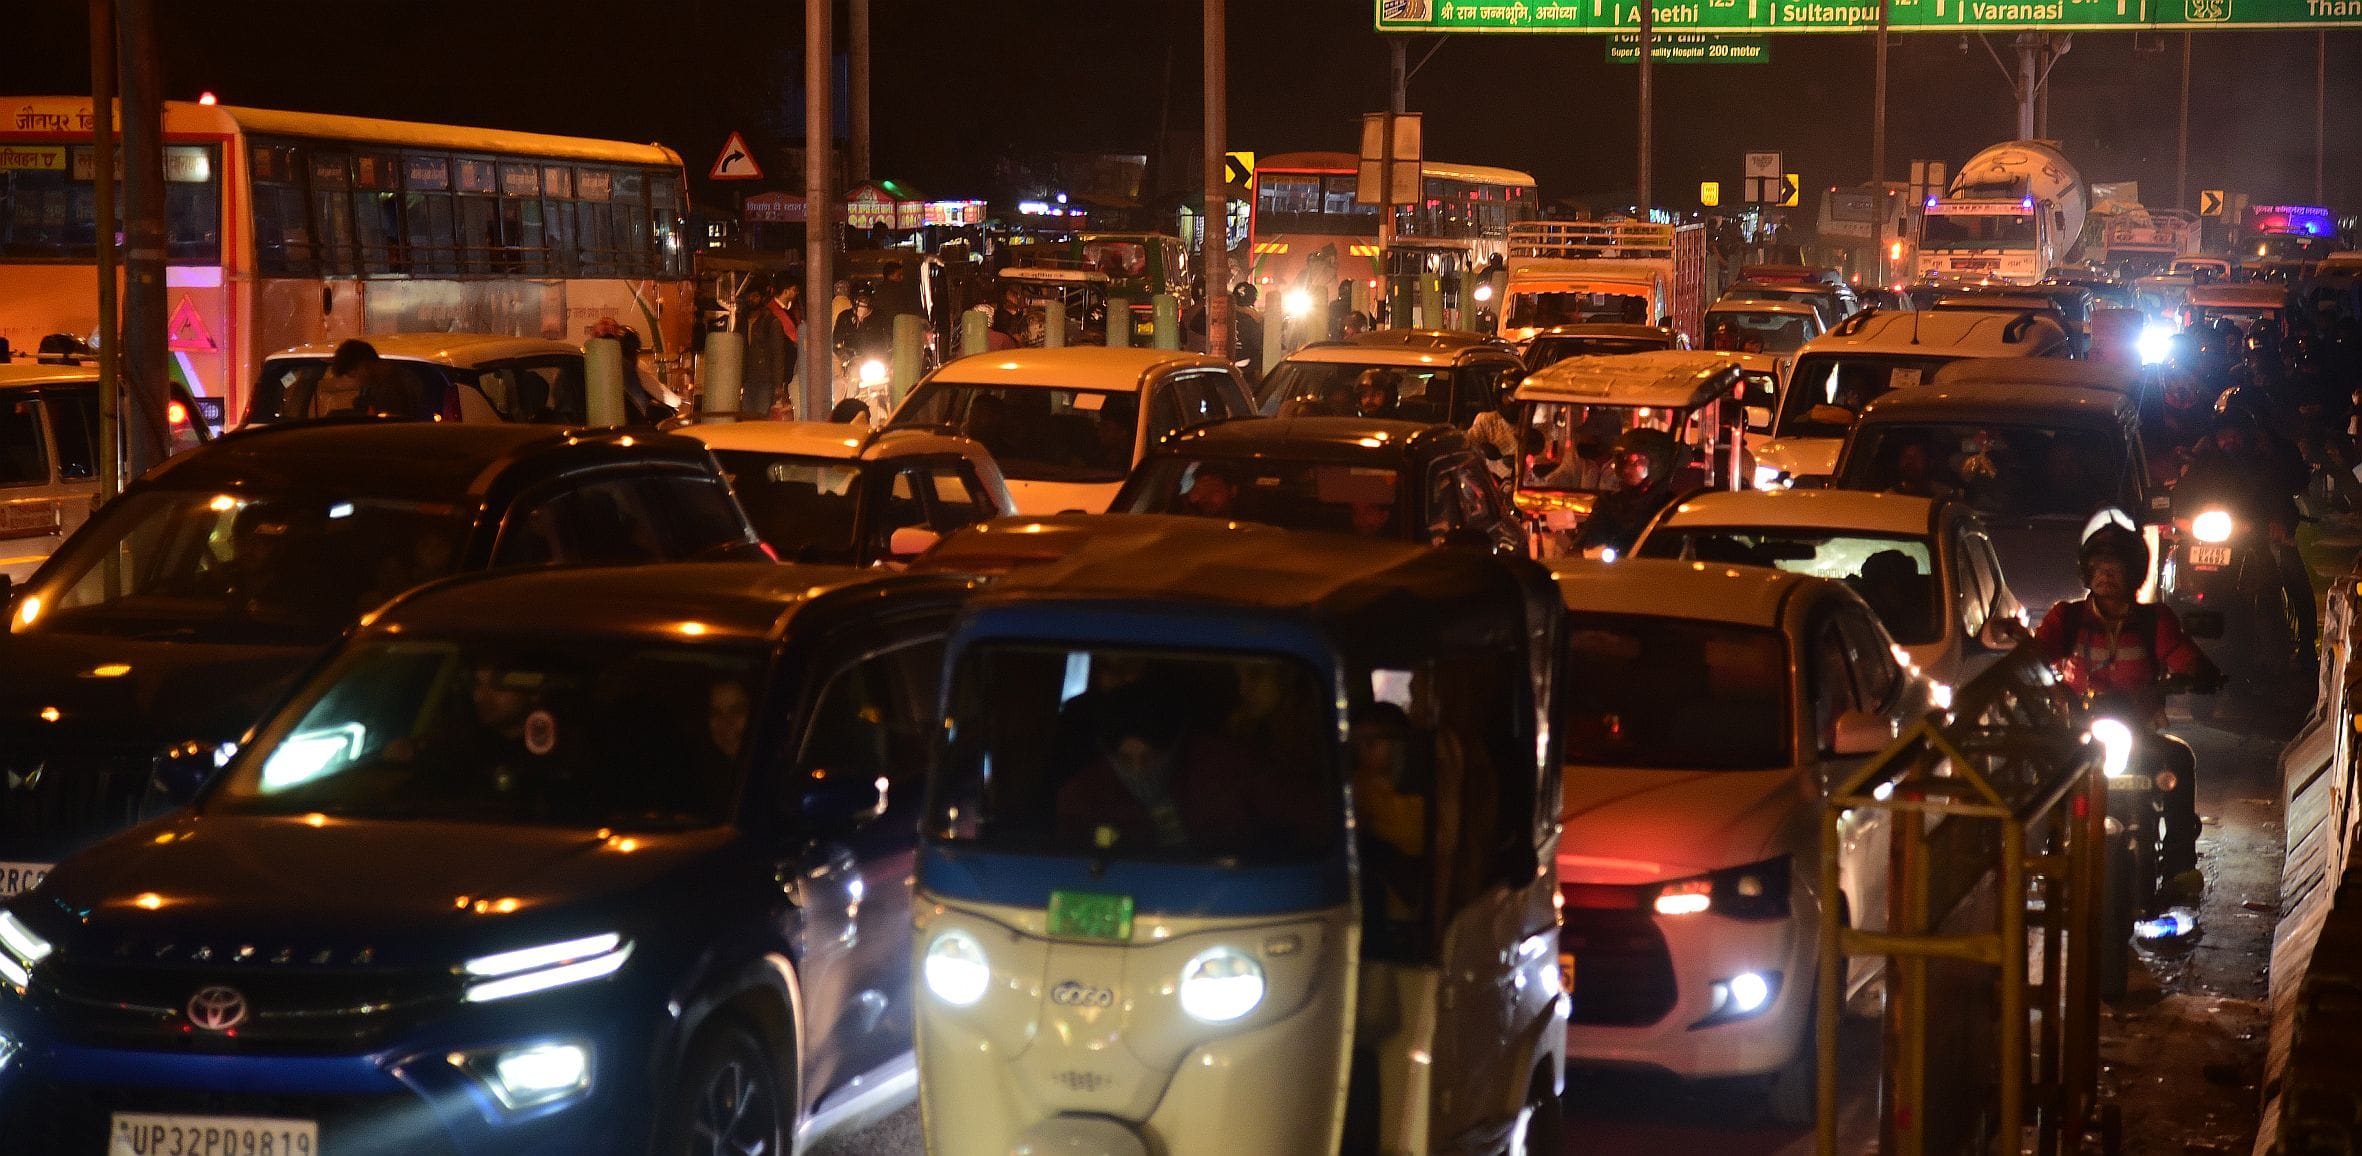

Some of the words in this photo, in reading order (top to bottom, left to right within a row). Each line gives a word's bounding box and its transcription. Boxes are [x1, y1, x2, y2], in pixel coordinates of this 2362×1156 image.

[1440, 1, 1454, 20] श्री
[1456, 6, 1477, 20] राम
[1480, 1, 1532, 25] जन्मभूमि,
[1535, 1, 1578, 20] अयोध्या
[1972, 0, 2064, 20] Varanasi
[2306, 0, 2361, 17] Than
[1672, 47, 1704, 58] Hospital
[1708, 44, 1729, 57] 200
